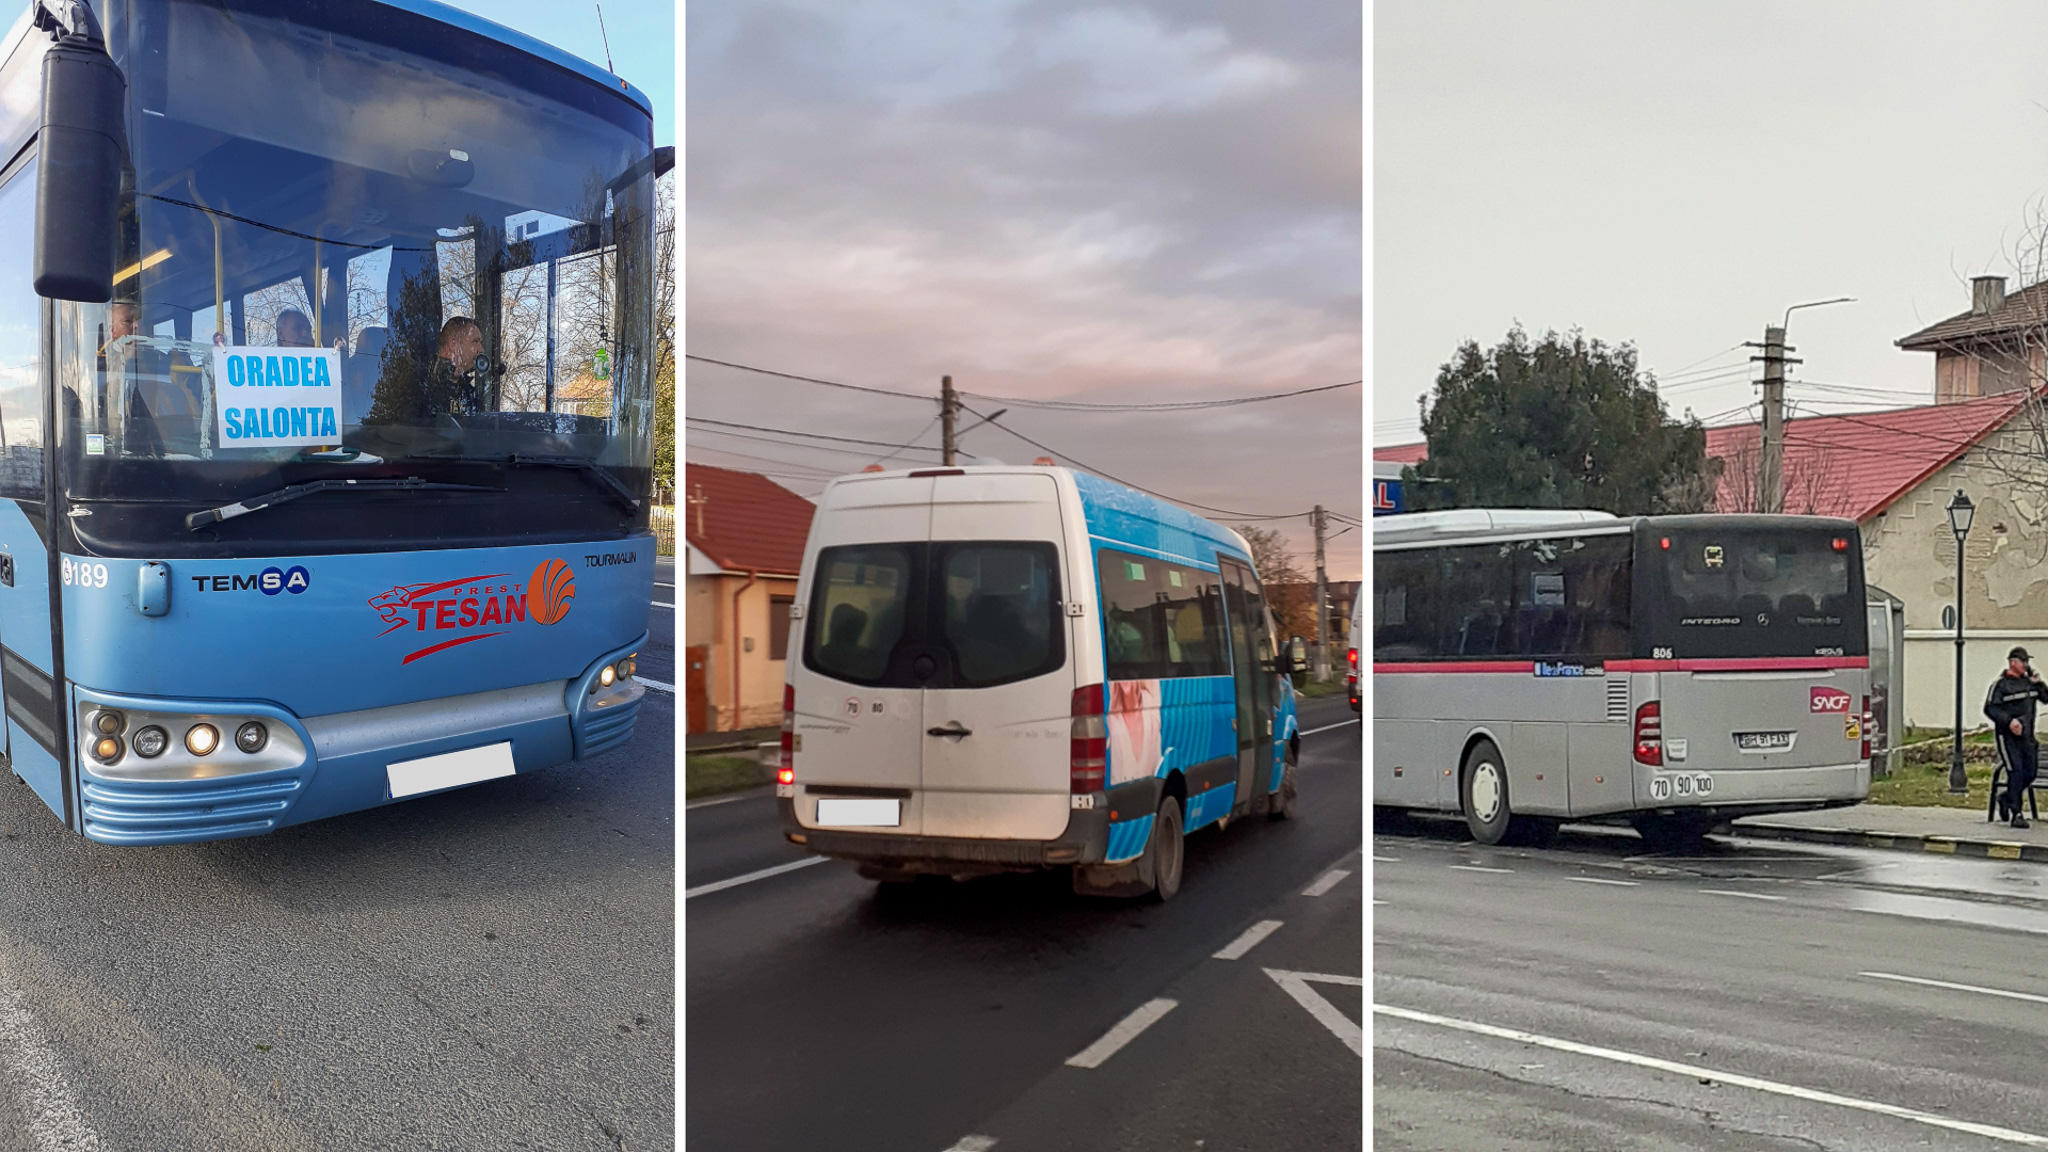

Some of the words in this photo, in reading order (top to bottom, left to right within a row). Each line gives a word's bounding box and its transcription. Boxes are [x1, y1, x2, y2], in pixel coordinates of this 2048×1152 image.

[227, 354, 331, 388] ORADEA
[224, 406, 337, 440] SALONTA
[585, 551, 637, 568] TOURMALIN
[192, 571, 308, 592] TEMSA
[453, 583, 522, 596] PREST
[411, 593, 527, 631] TESAN
[1652, 647, 1673, 659] 806
[1812, 695, 1850, 710] SNCF
[1654, 780, 1668, 797] 70
[1678, 776, 1691, 794] 90
[1696, 777, 1712, 792] 100
